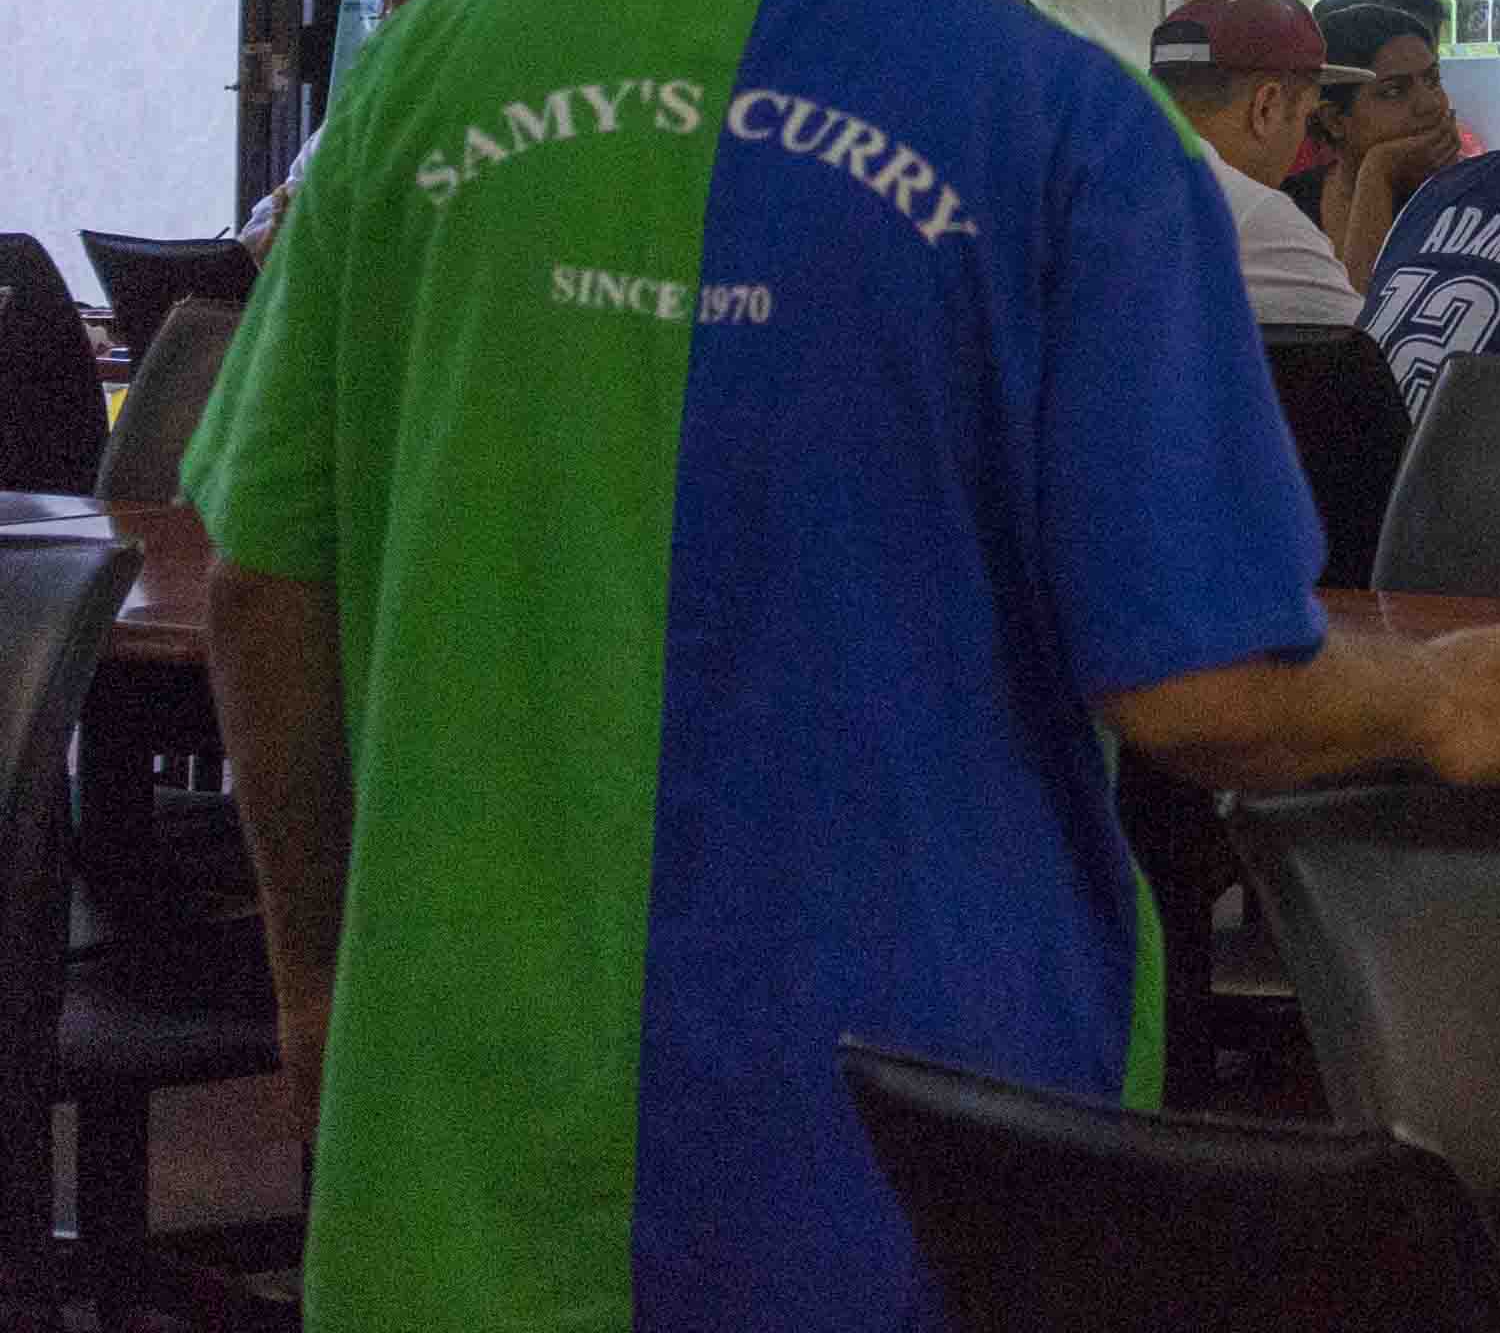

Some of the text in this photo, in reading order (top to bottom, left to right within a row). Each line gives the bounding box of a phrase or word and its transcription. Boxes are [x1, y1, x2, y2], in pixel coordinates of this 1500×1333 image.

[415, 79, 979, 246] SAMY'S CURRY
[551, 262, 772, 324] SINCE 1970
